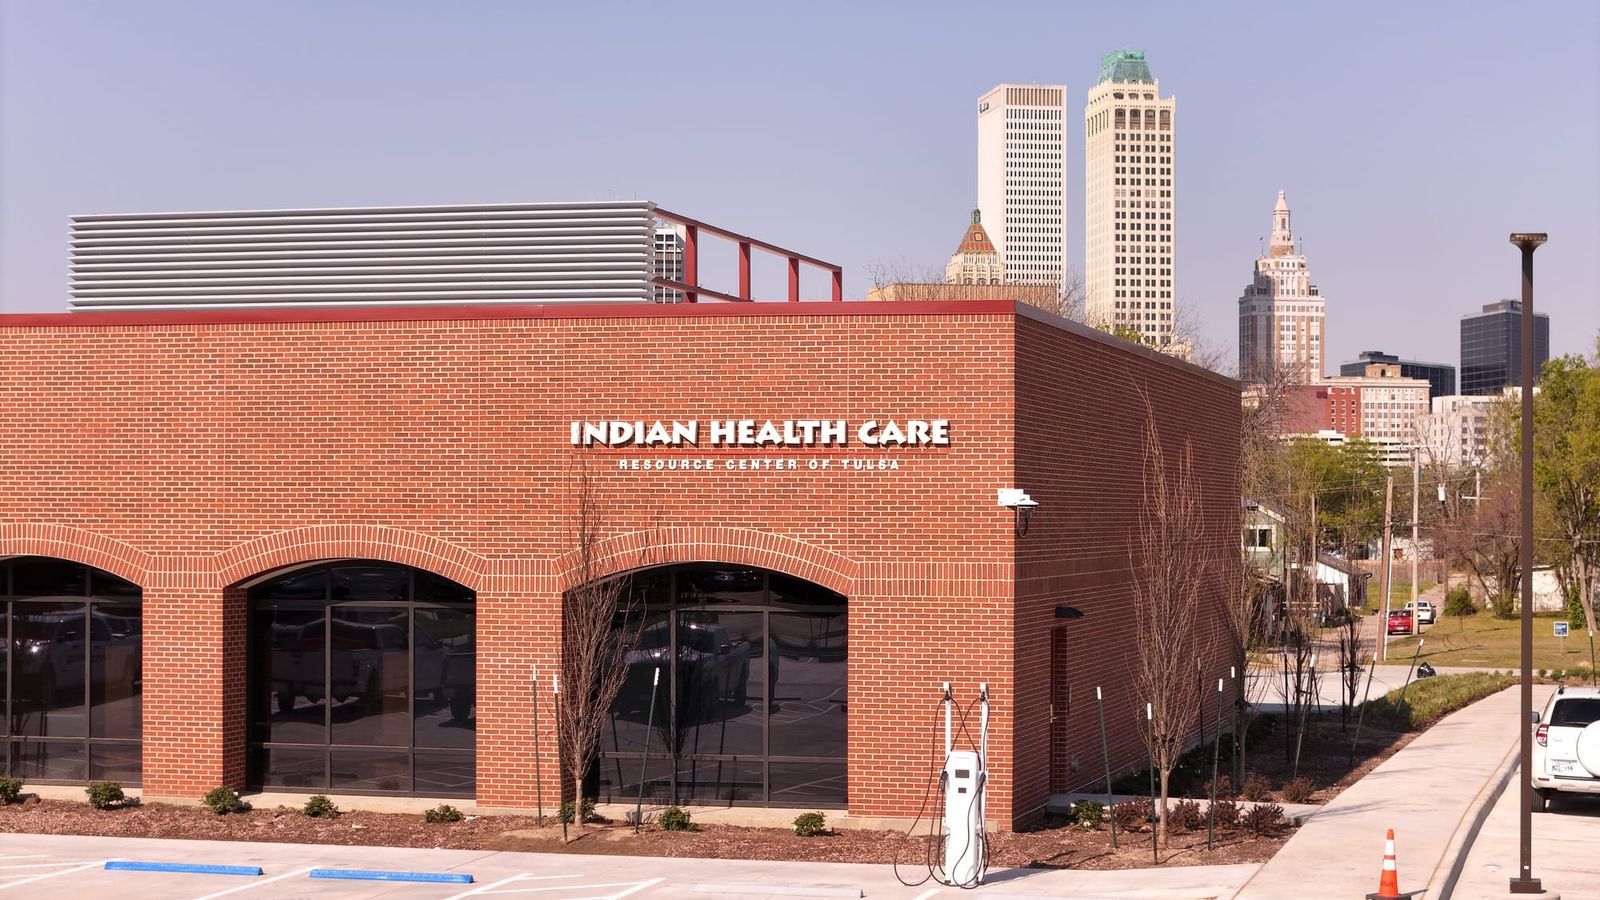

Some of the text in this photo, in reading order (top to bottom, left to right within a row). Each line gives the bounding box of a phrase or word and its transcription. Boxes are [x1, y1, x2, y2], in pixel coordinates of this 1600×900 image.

[569, 419, 950, 446] INDIAN HEALTH CARE
[619, 458, 901, 470] RESOURCE CENTER OF TULSA
